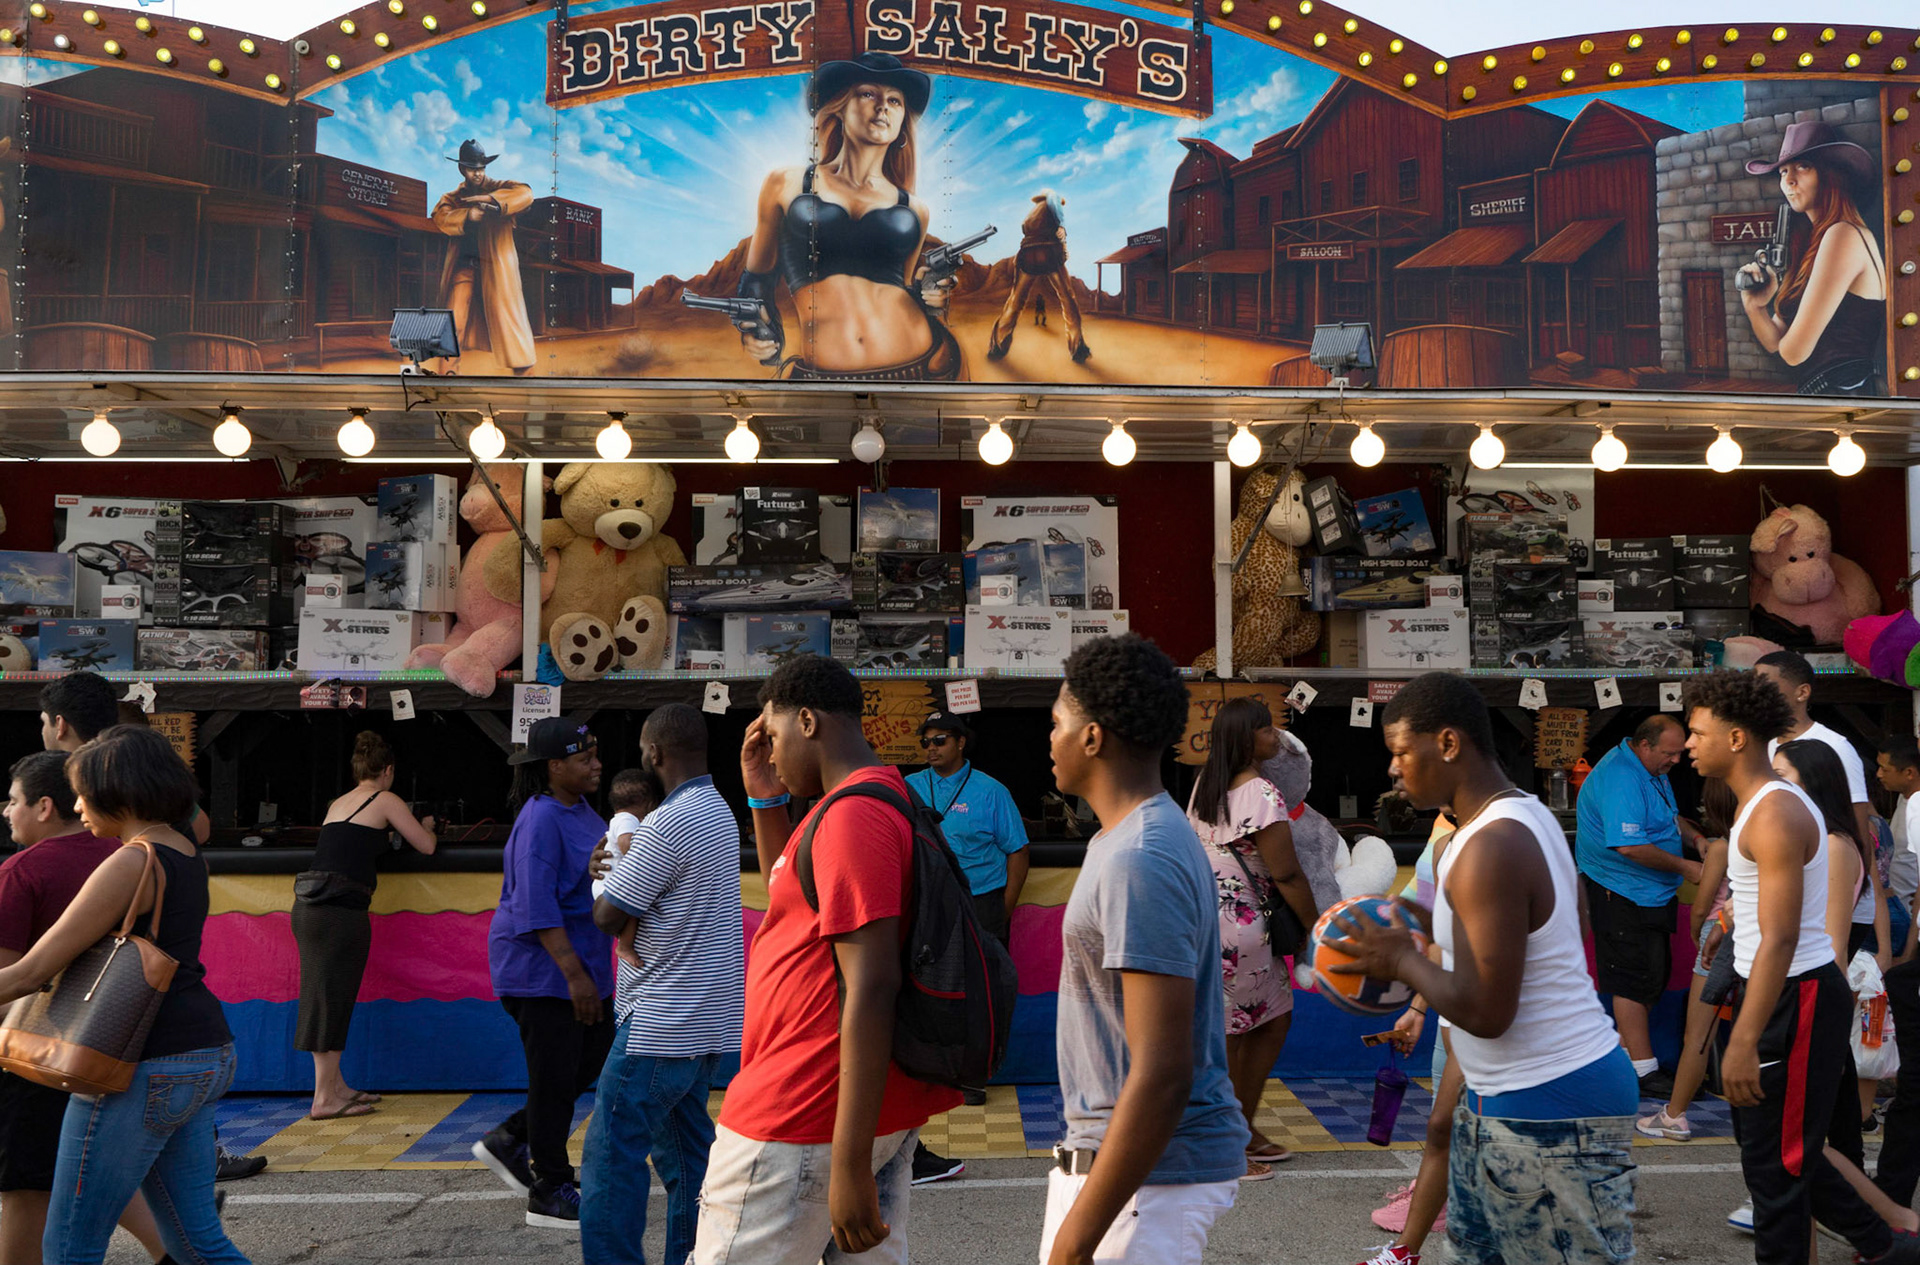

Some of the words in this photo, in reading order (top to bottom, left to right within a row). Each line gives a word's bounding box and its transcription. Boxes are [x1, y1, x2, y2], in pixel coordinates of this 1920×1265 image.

[562, 0, 816, 94] DIRTY
[864, 0, 1190, 102] SALLY'S
[341, 168, 399, 195] GENERAL
[347, 185, 388, 206] STORE
[1469, 196, 1526, 217] SHERIFF
[565, 206, 595, 225] BANK
[1722, 220, 1776, 241] JAIL
[1300, 246, 1342, 257] SALOON
[88, 506, 123, 519] X6
[993, 505, 1025, 517] X6
[1025, 505, 1050, 514] SUPER
[156, 520, 180, 529] ROCK
[1359, 559, 1379, 567] HIGH
[1379, 559, 1405, 567] SPEED
[1406, 559, 1430, 567] BOAT
[853, 570, 876, 578] ROCK
[154, 581, 179, 591] ROCK
[725, 578, 753, 586] BOAT
[322, 618, 390, 634] X-SERIES
[987, 615, 1051, 631] X-SERIES
[1387, 619, 1450, 633] X-SERIES
[832, 637, 855, 646] ROCK
[863, 689, 882, 702] OT
[165, 717, 181, 726] RED
[1562, 713, 1577, 721] RED
[171, 726, 181, 734] BE
[862, 713, 890, 736] RTY
[1546, 721, 1566, 729] MUST
[1569, 721, 1579, 730] BE
[867, 719, 911, 750] ALLY'S
[1561, 729, 1580, 738] FROM
[1545, 738, 1563, 746] CARD
[1566, 739, 1576, 747] TO
